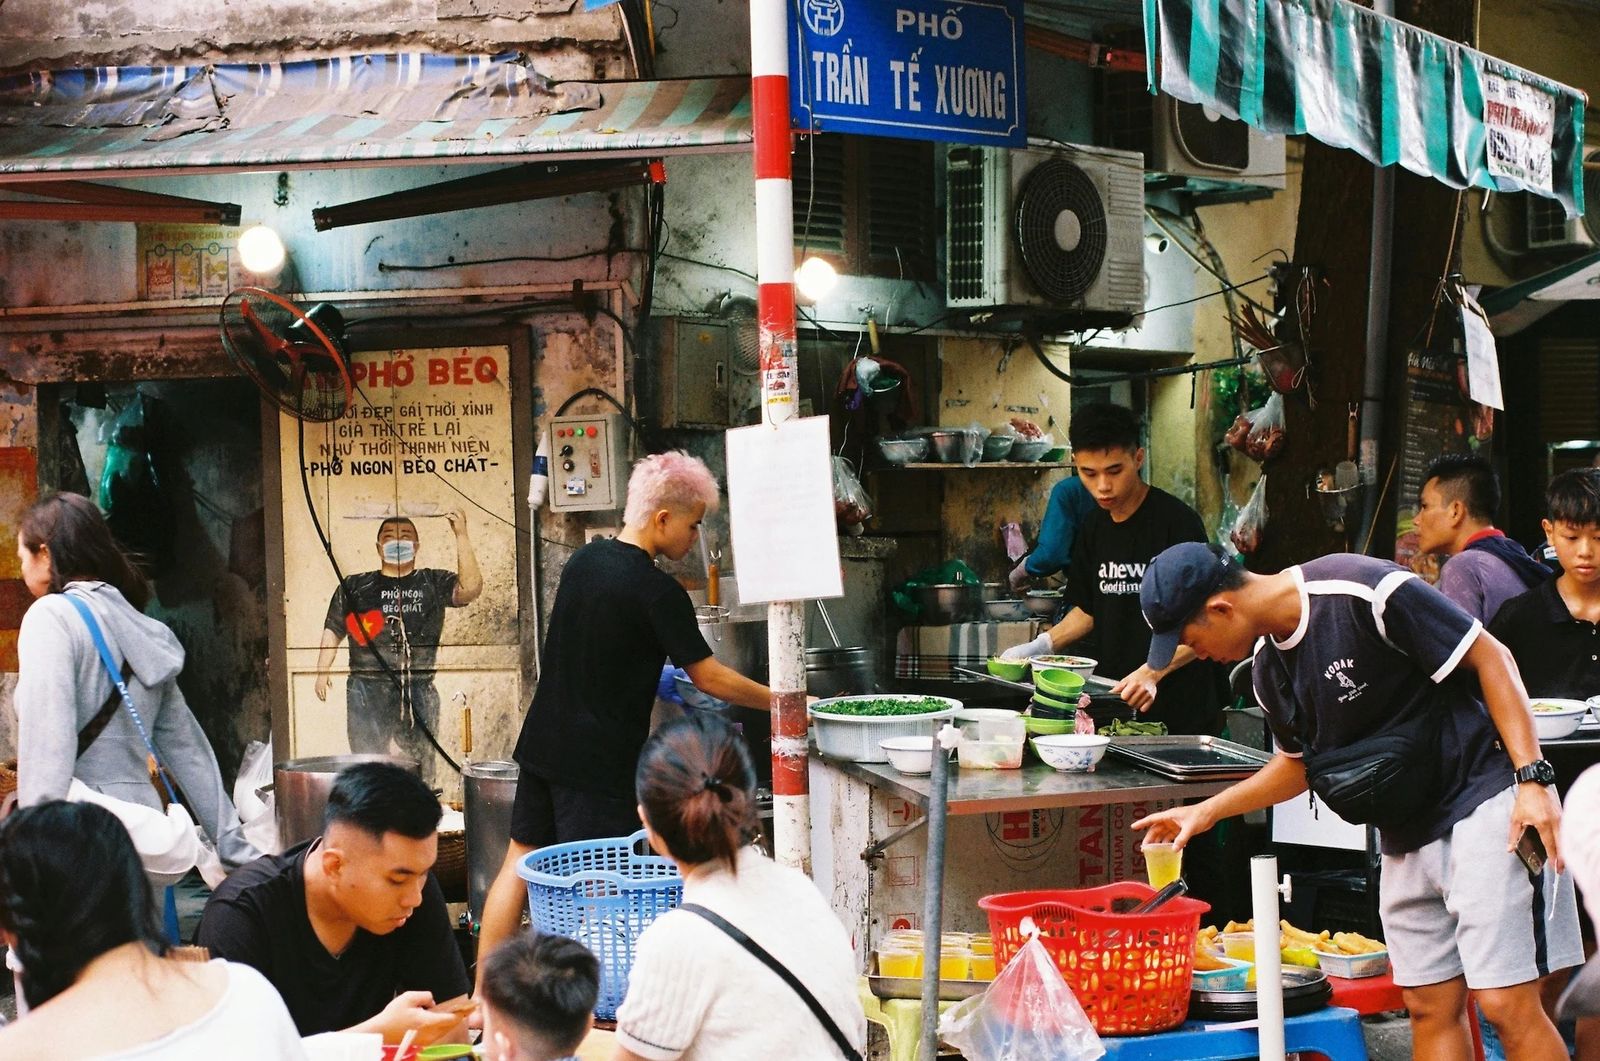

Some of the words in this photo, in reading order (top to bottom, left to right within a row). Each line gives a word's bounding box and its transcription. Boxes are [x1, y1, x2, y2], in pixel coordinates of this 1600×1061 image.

[896, 6, 964, 40] PHỐ
[812, 38, 869, 106] TRẦN
[890, 47, 922, 112] TẾ
[935, 64, 1006, 120] XƯƠNG
[350, 350, 414, 388] PHỞ
[429, 348, 498, 385] BÉO
[361, 406, 393, 421] ĐẸP
[397, 417, 427, 437] TRẺ
[319, 440, 354, 456] NHƯ
[360, 438, 392, 455] THỜI
[399, 441, 446, 455] THANH
[451, 435, 490, 454] NIÊN
[351, 461, 393, 476] NGON
[403, 455, 436, 474] BÉO
[402, 589, 424, 599] NGON
[382, 600, 400, 613] BÉO
[401, 598, 423, 613] CHẤT
[1324, 659, 1354, 680] KODAK
